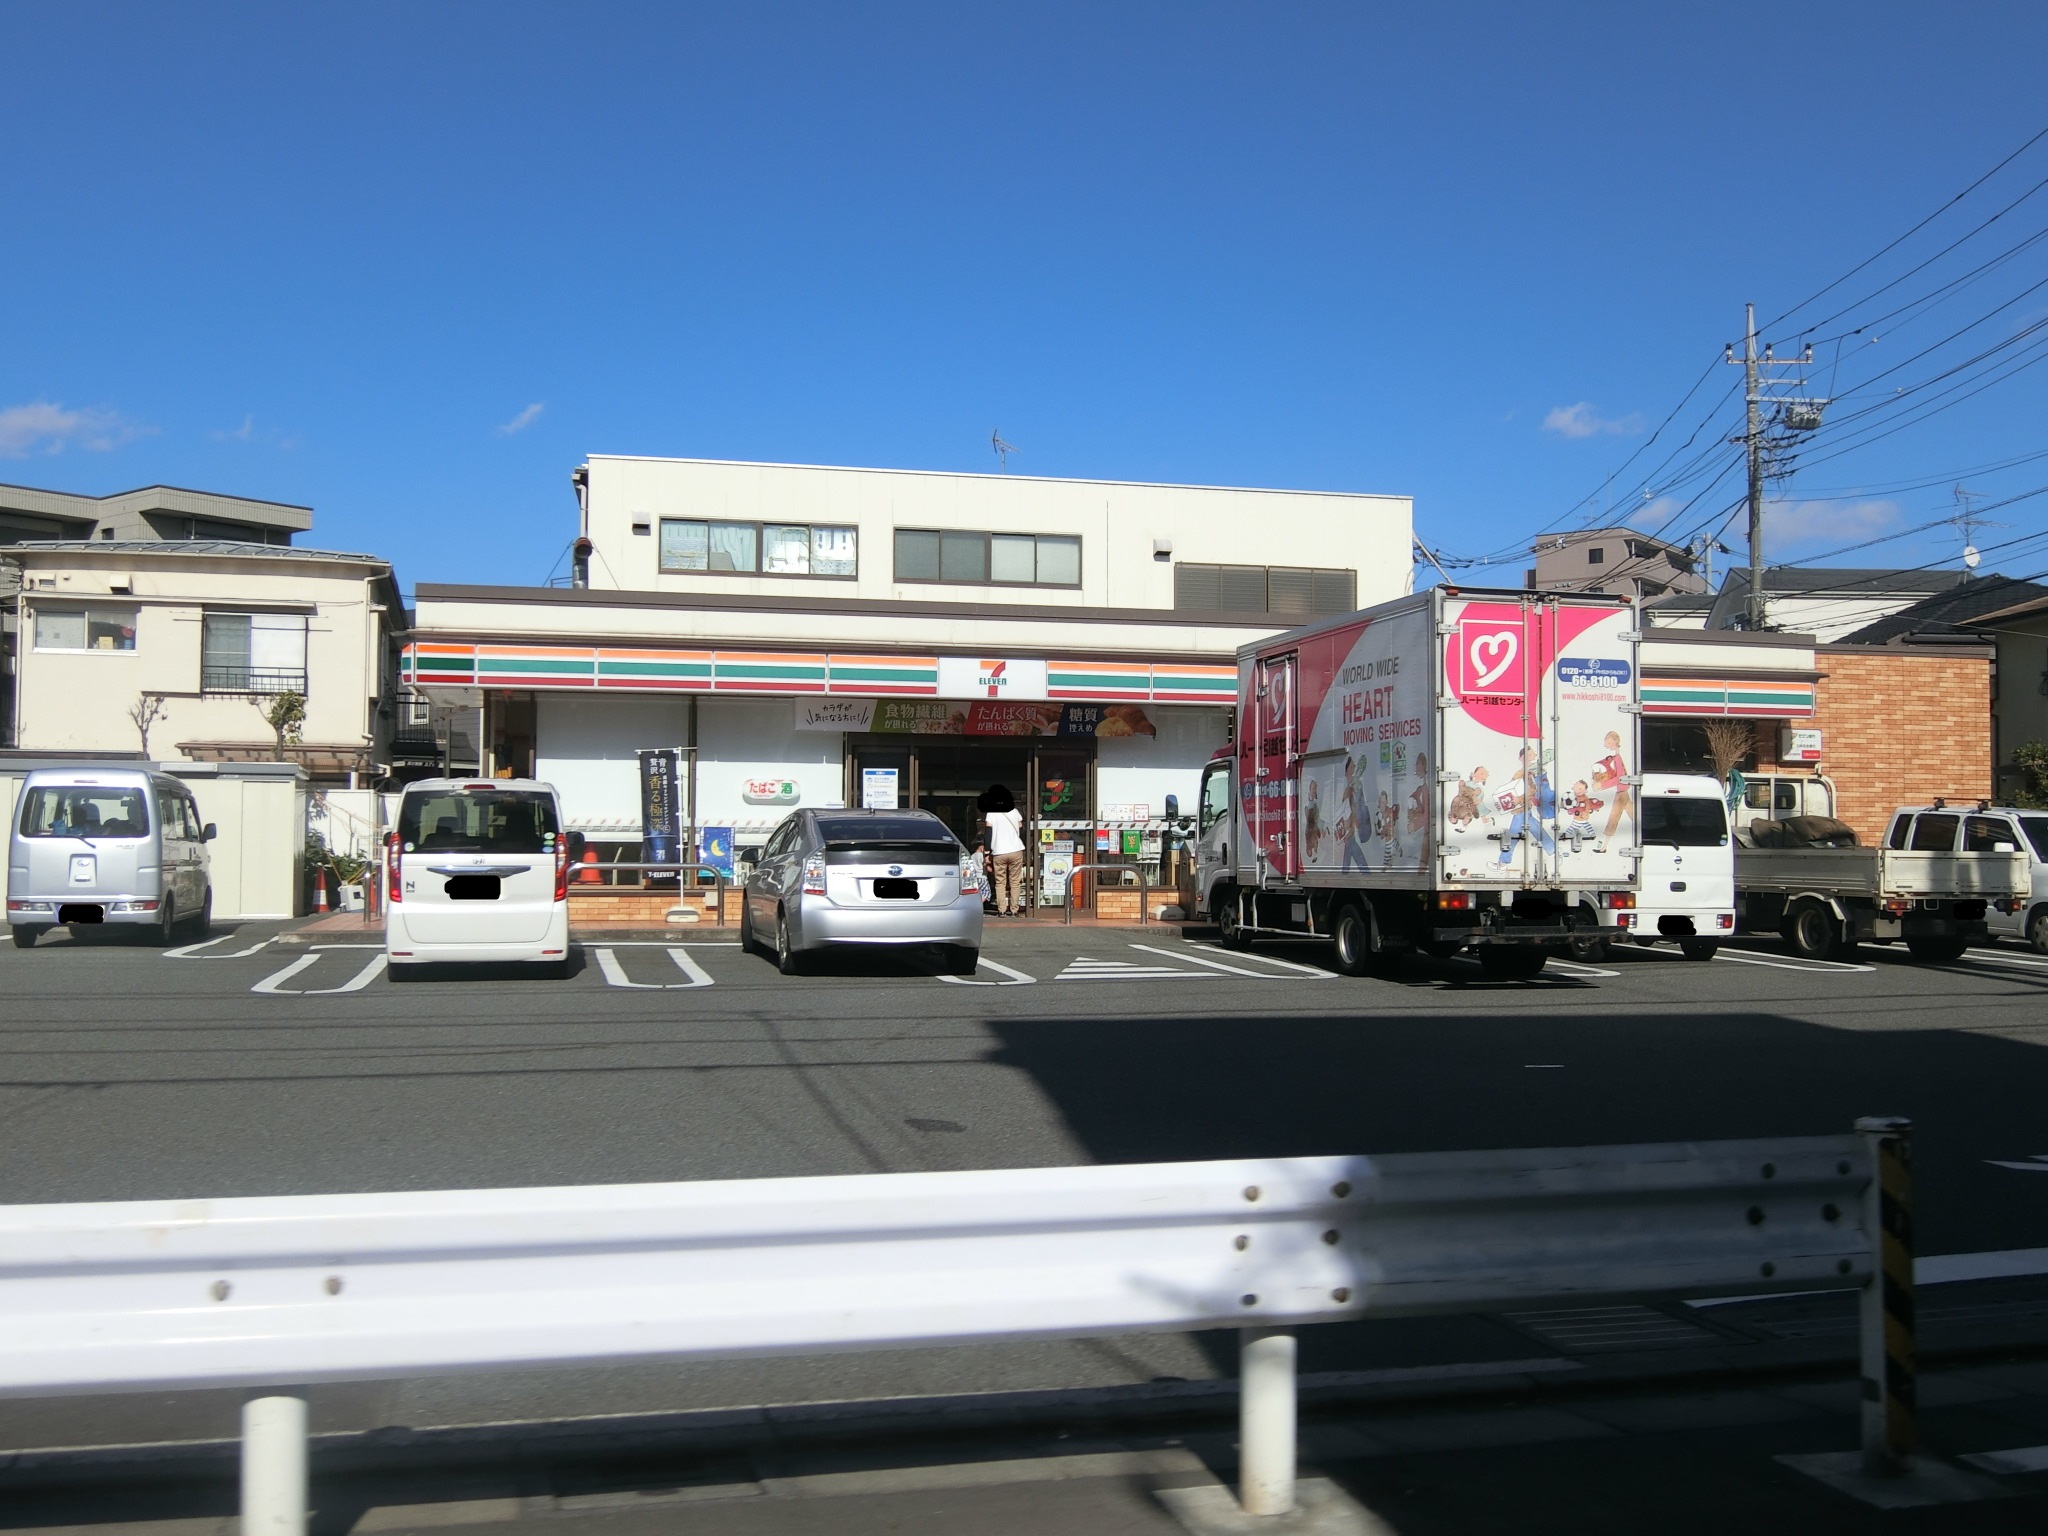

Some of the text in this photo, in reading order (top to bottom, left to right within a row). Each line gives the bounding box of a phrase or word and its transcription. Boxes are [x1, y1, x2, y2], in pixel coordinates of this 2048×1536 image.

[1343, 656, 1399, 685] WORLD WIDE
[1571, 675, 1618, 688] 66-8100
[1461, 696, 1525, 706] ハート引越センター
[1561, 692, 1627, 702] www.hikkoshi8100.com
[822, 703, 853, 712] カラダが
[1343, 685, 1394, 724] HEART
[884, 703, 946, 720] 食物繊維
[977, 706, 1038, 721] たんぱく質
[1068, 707, 1098, 722] 糖質
[884, 719, 916, 729] が摂れる
[977, 721, 1009, 731] が摂れる
[1068, 723, 1093, 733] 控えめ
[1343, 718, 1421, 746] MOVING SERVICES
[649, 758, 659, 774] 贅沢
[749, 782, 776, 793] たばこ
[781, 782, 793, 794] 酒
[649, 775, 664, 831] 香る極深
